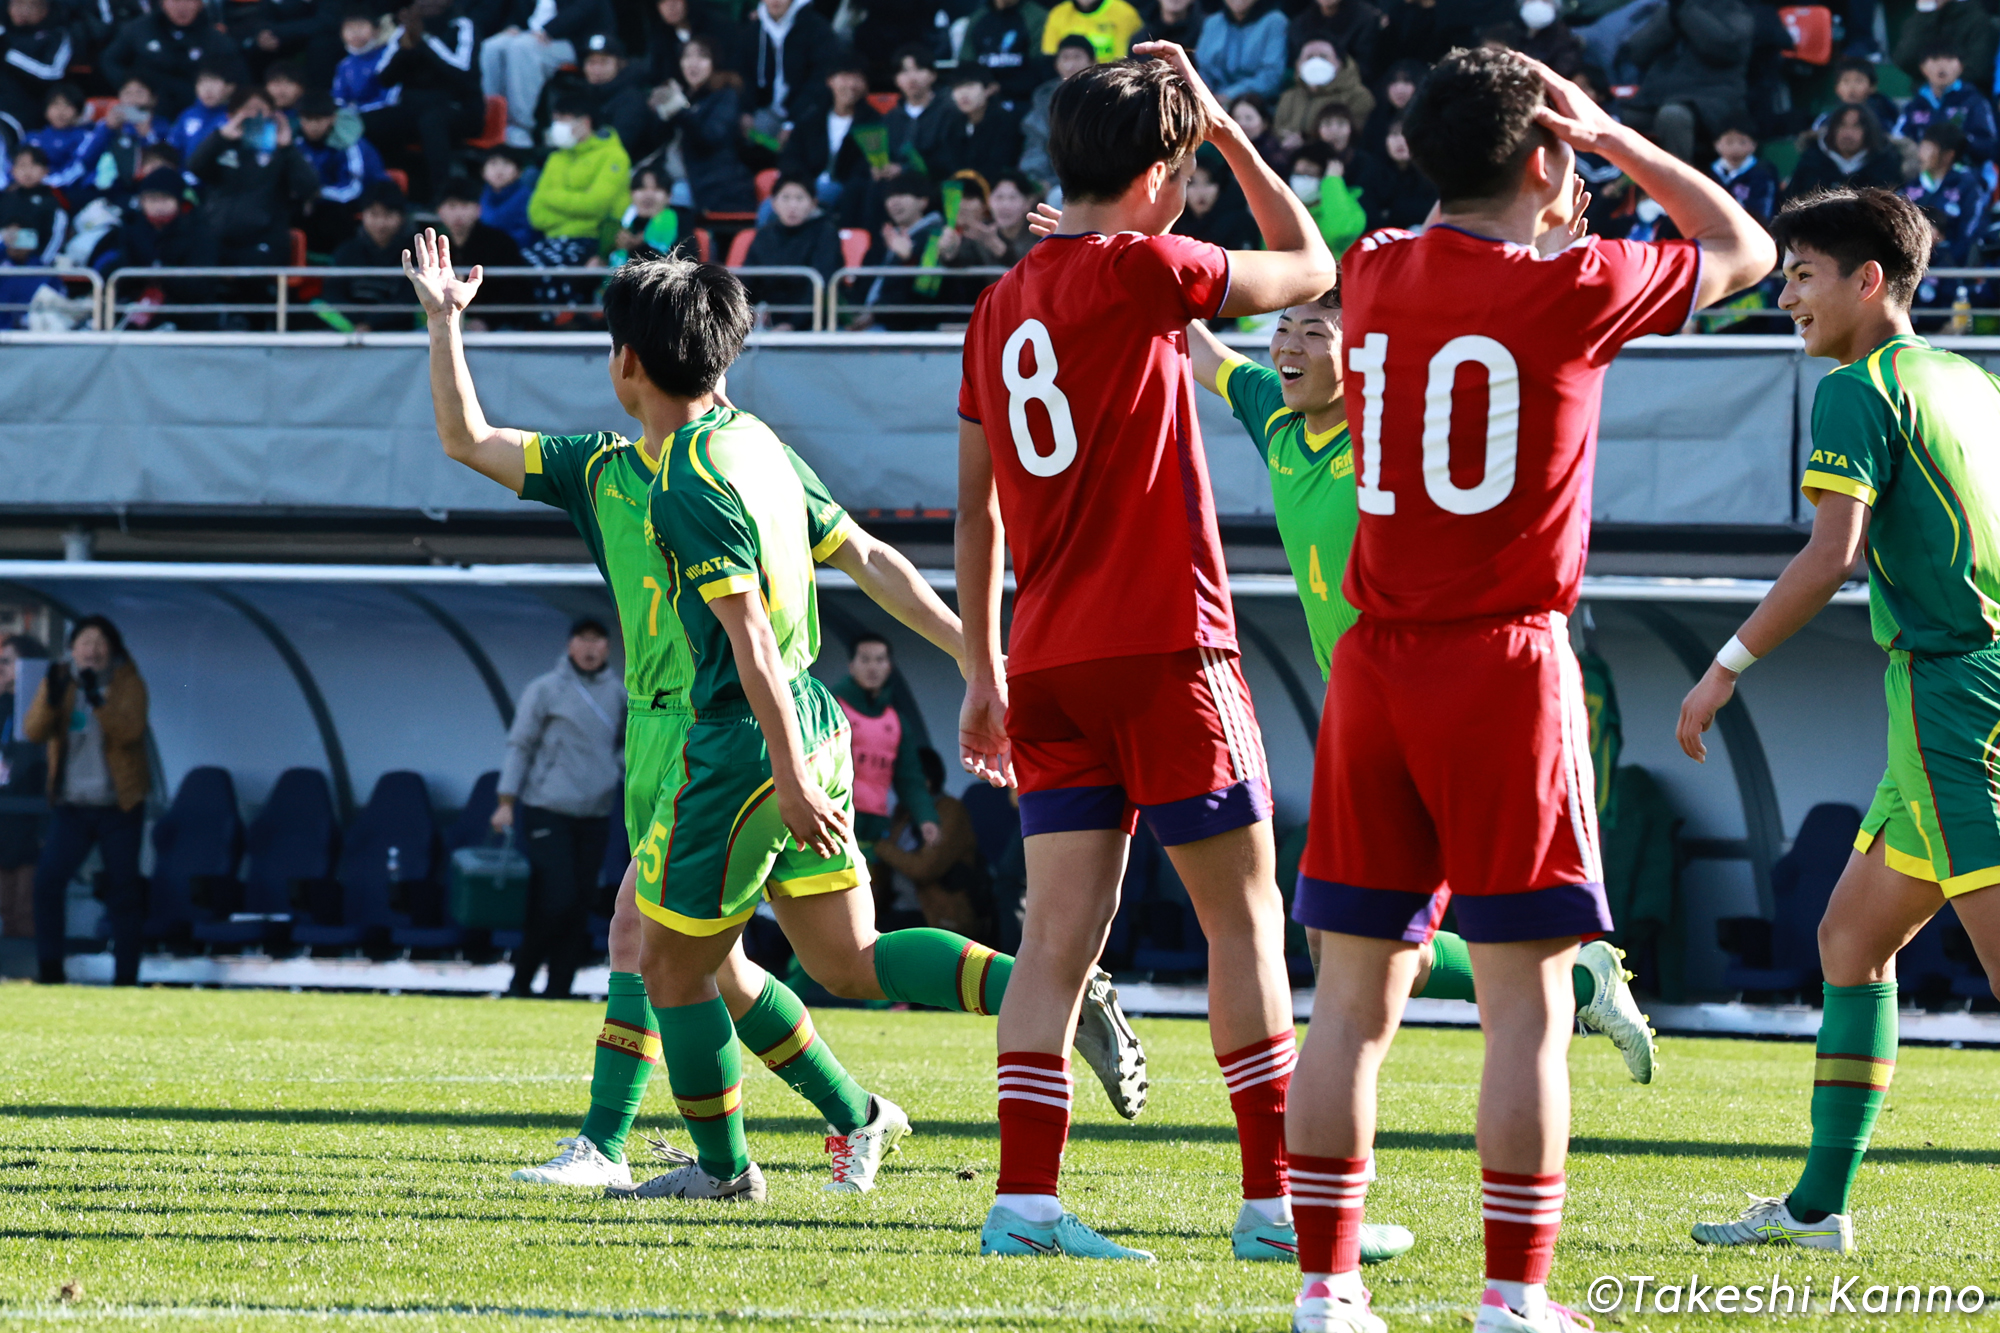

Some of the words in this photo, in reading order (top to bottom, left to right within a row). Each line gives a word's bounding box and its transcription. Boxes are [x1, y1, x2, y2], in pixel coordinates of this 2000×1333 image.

[1002, 318, 1078, 477] 8
[1349, 332, 1520, 515] 10
[1309, 544, 1328, 601] 4
[643, 576, 662, 636] 7
[597, 1033, 640, 1051] LETA
